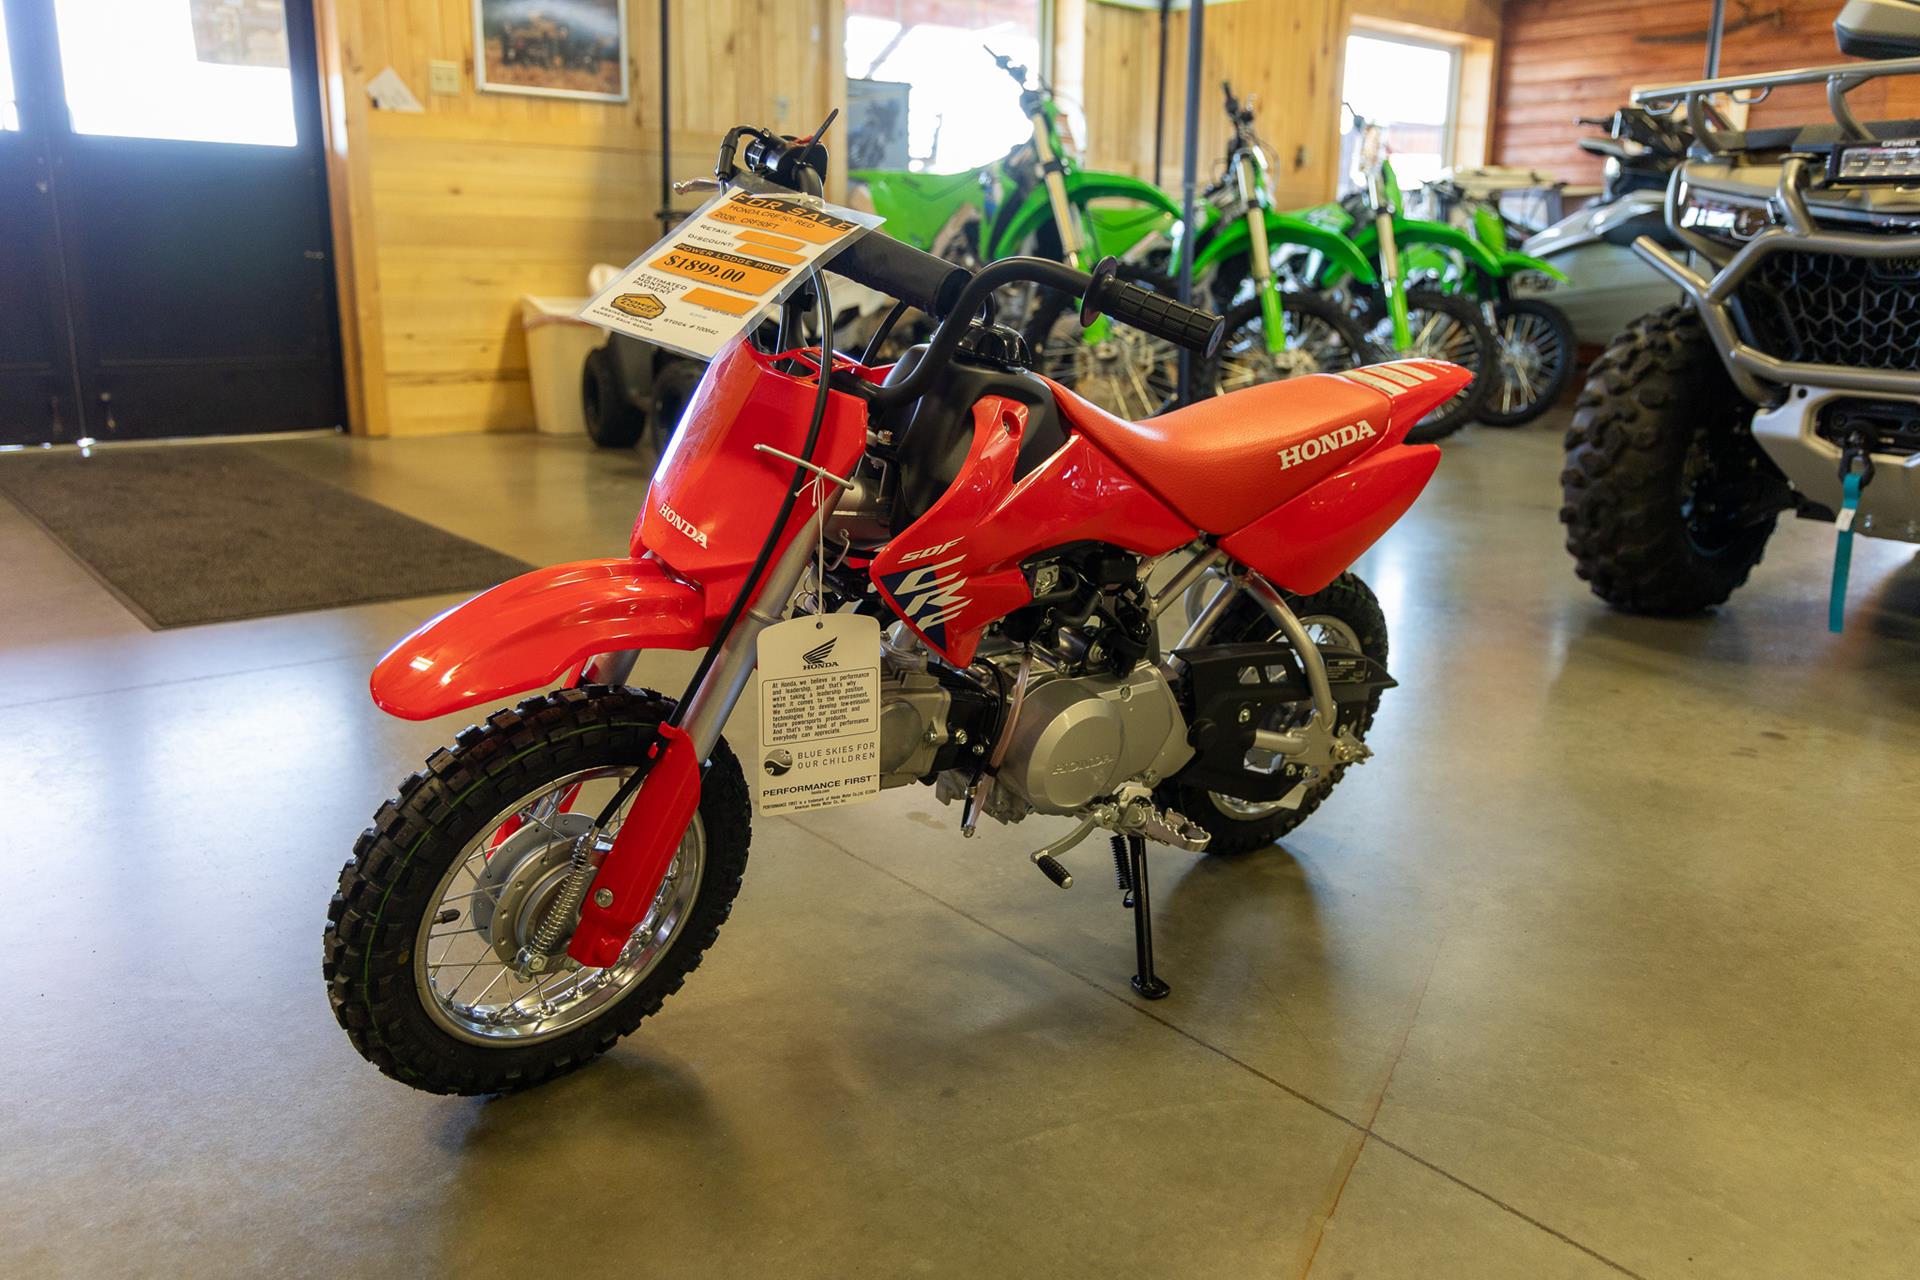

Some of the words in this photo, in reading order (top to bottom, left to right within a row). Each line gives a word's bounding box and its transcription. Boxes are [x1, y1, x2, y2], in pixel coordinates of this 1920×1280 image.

[729, 204, 760, 215] HONDA
[794, 219, 816, 229] RED
[731, 193, 783, 210] FOR
[787, 207, 854, 231] SALE
[700, 224, 732, 235] RETAIL:
[687, 233, 734, 248] DISCOUNT:
[677, 243, 713, 256] POWER
[716, 251, 754, 266] LODGE
[754, 262, 788, 274] PRICE
[664, 254, 746, 283] $1899.00
[632, 280, 672, 295] PAYMENT
[620, 301, 656, 313] LODGE
[621, 297, 660, 310] POWER
[663, 318, 686, 327] STOCK
[1276, 419, 1377, 470] HONDA
[658, 501, 708, 550] HONDA
[897, 535, 966, 564] 50F
[803, 661, 839, 671] HONDA
[811, 677, 827, 685] believe
[840, 672, 870, 681] performance
[817, 689, 841, 697] leadership
[845, 686, 864, 694] position
[841, 698, 870, 707] low-emission
[772, 713, 804, 722] technologies
[830, 707, 848, 715] current
[792, 717, 821, 727] powersports
[840, 717, 869, 727] performance
[772, 733, 797, 741] everybody
[797, 749, 822, 760] BLUE
[825, 745, 854, 756] SKIES
[857, 742, 875, 751] FOR
[797, 759, 819, 770] OUR
[822, 752, 875, 766] CHILDREN
[762, 780, 841, 797] PERFORMANCE
